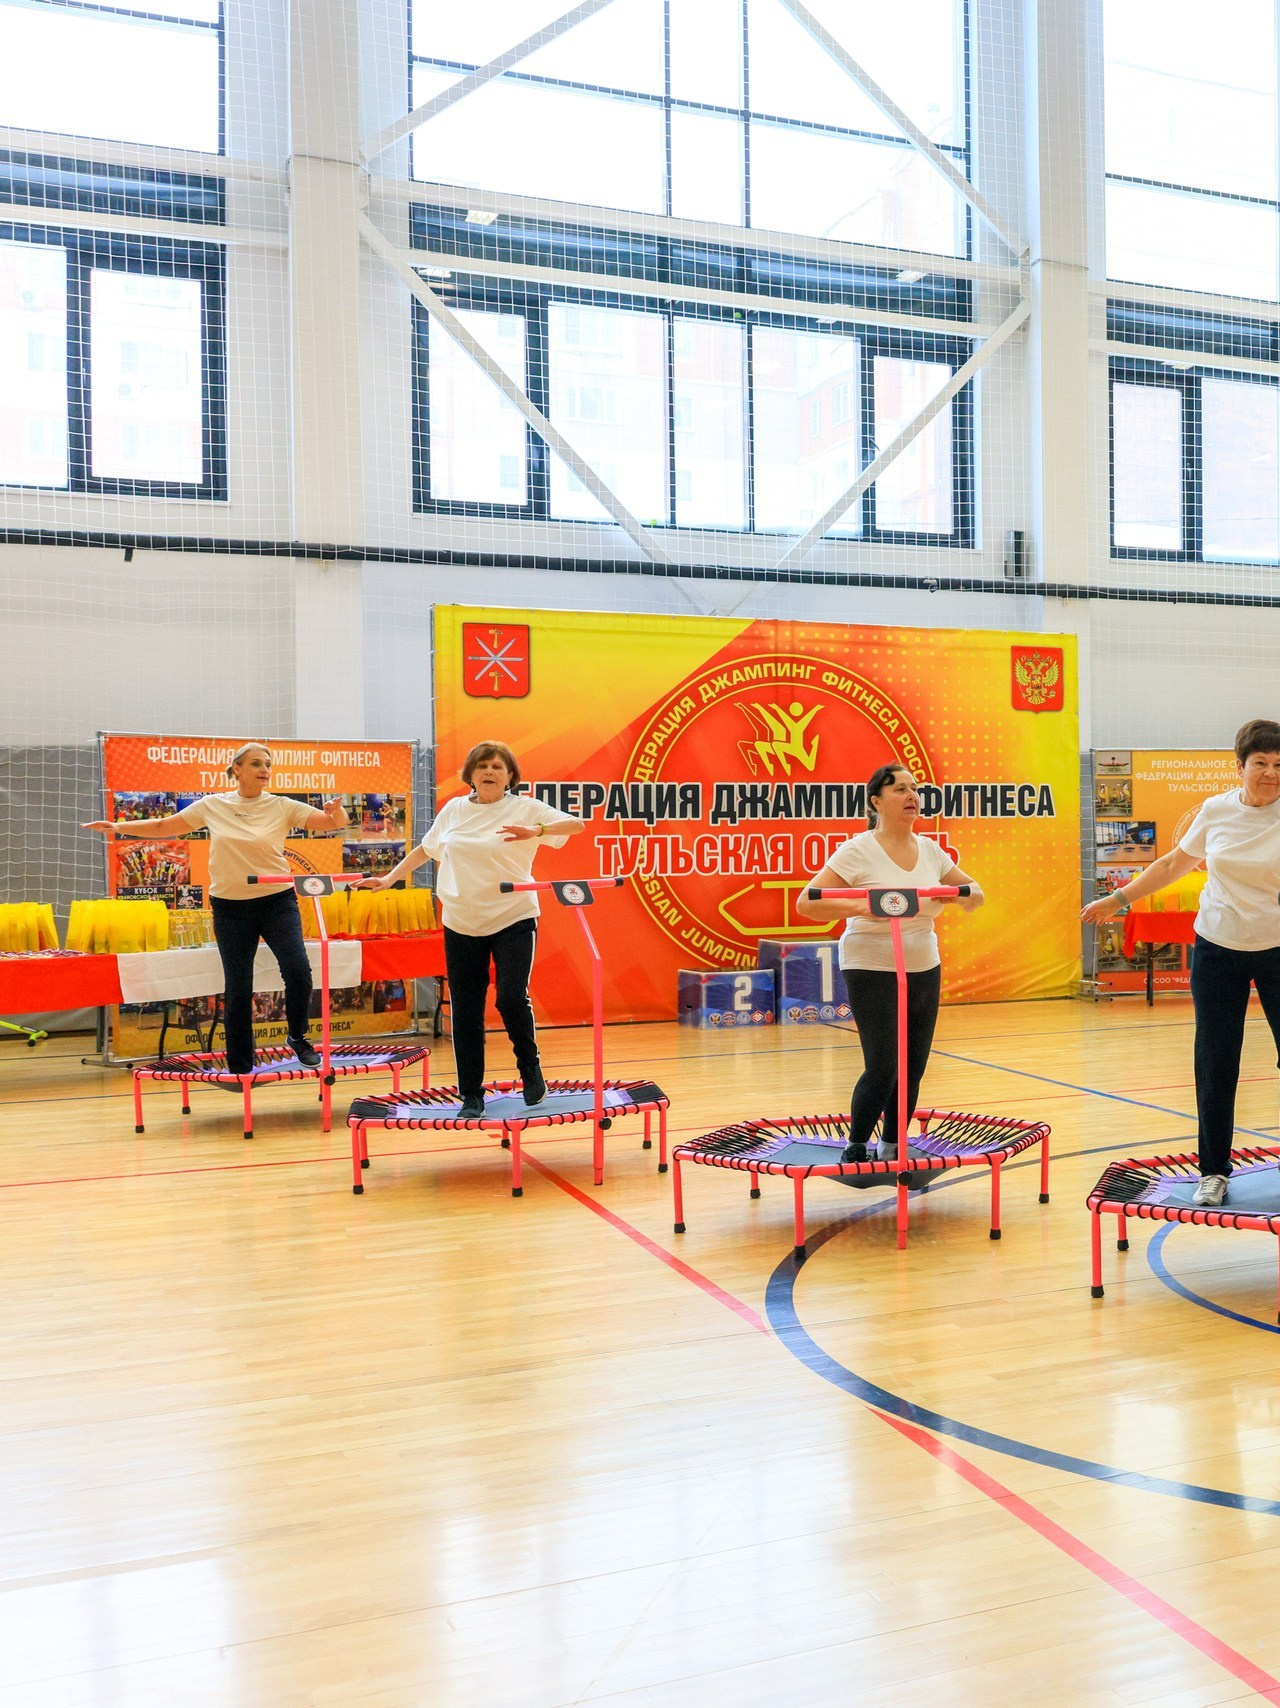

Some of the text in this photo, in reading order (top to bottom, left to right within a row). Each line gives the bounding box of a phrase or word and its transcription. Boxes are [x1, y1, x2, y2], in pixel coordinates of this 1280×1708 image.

[633, 662, 927, 785] ДЕРАЦИЯ ДЖАМПИНГ ФИТНЕСА РОСС
[147, 746, 381, 768] ФЕДЕРАЦИЯ МПИНГ ФИТНЕСА
[1151, 760, 1227, 769] РЕГИОНАЛЬНОЕ
[275, 772, 336, 789] ОБЛАСТИ
[1135, 771, 1244, 781] ФЕДЕРАЦИИ ДЖАМПИ
[1167, 782, 1219, 792] ТУЛЬСКОЙ
[511, 780, 1056, 827] ДЕРАЦИЯ ДЖАМПИ ФИТНЕСА
[595, 833, 794, 877] ТУЛЬСКАЯ
[680, 927, 758, 967] JUMPIN
[816, 947, 833, 1002] 1
[734, 976, 752, 1011] 2
[316, 1020, 354, 1032] ФТНЕСА"
